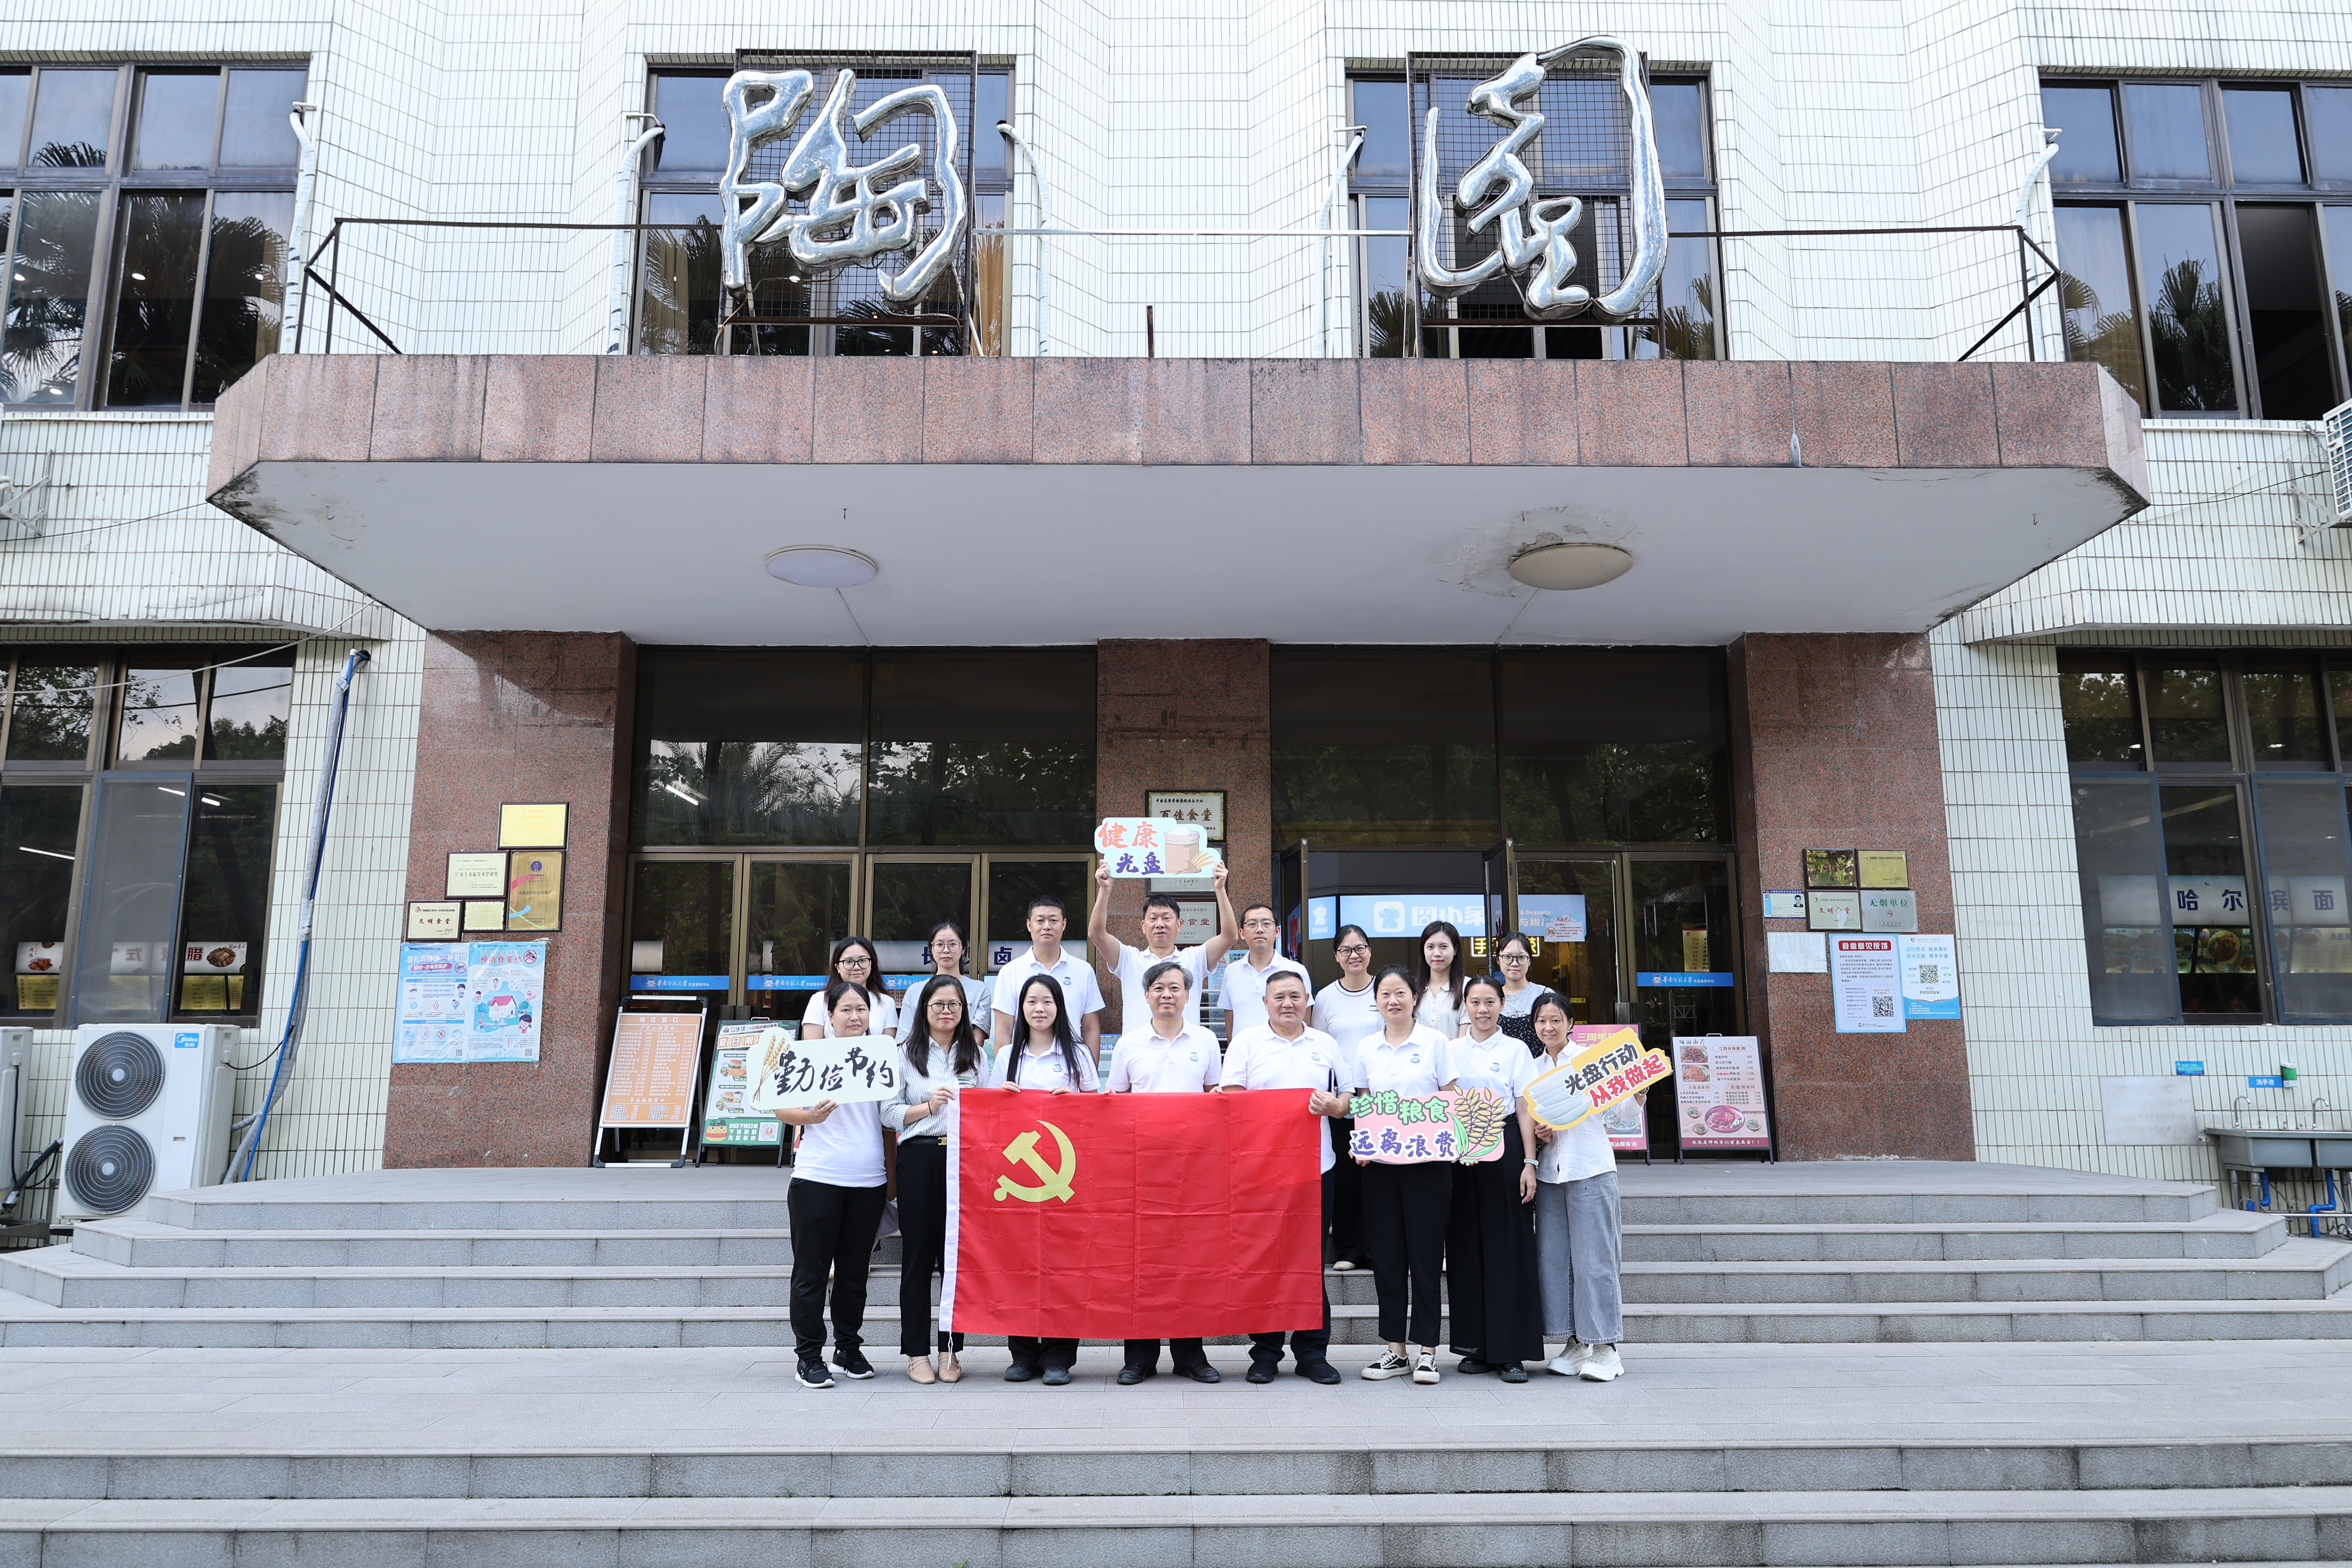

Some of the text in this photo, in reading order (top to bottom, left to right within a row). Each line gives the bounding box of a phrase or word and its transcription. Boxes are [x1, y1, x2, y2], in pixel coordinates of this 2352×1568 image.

[1159, 808, 1212, 822] 百佳食堂
[1098, 820, 1159, 849] 健康
[1115, 851, 1165, 875] 光盘
[1814, 864, 1850, 873] 文明食堂
[1869, 898, 1909, 907] 无烟单位
[2177, 889, 2334, 911] 哈尔滨面
[717, 1036, 760, 1047] 夏日限
[773, 1046, 895, 1096] 勤俭节约
[1565, 1043, 1639, 1096] 光盘行动
[1589, 1054, 1666, 1107] 从我做起
[1349, 1090, 1449, 1125] 珍惜粮食
[1351, 1128, 1457, 1158] 远离浪费
